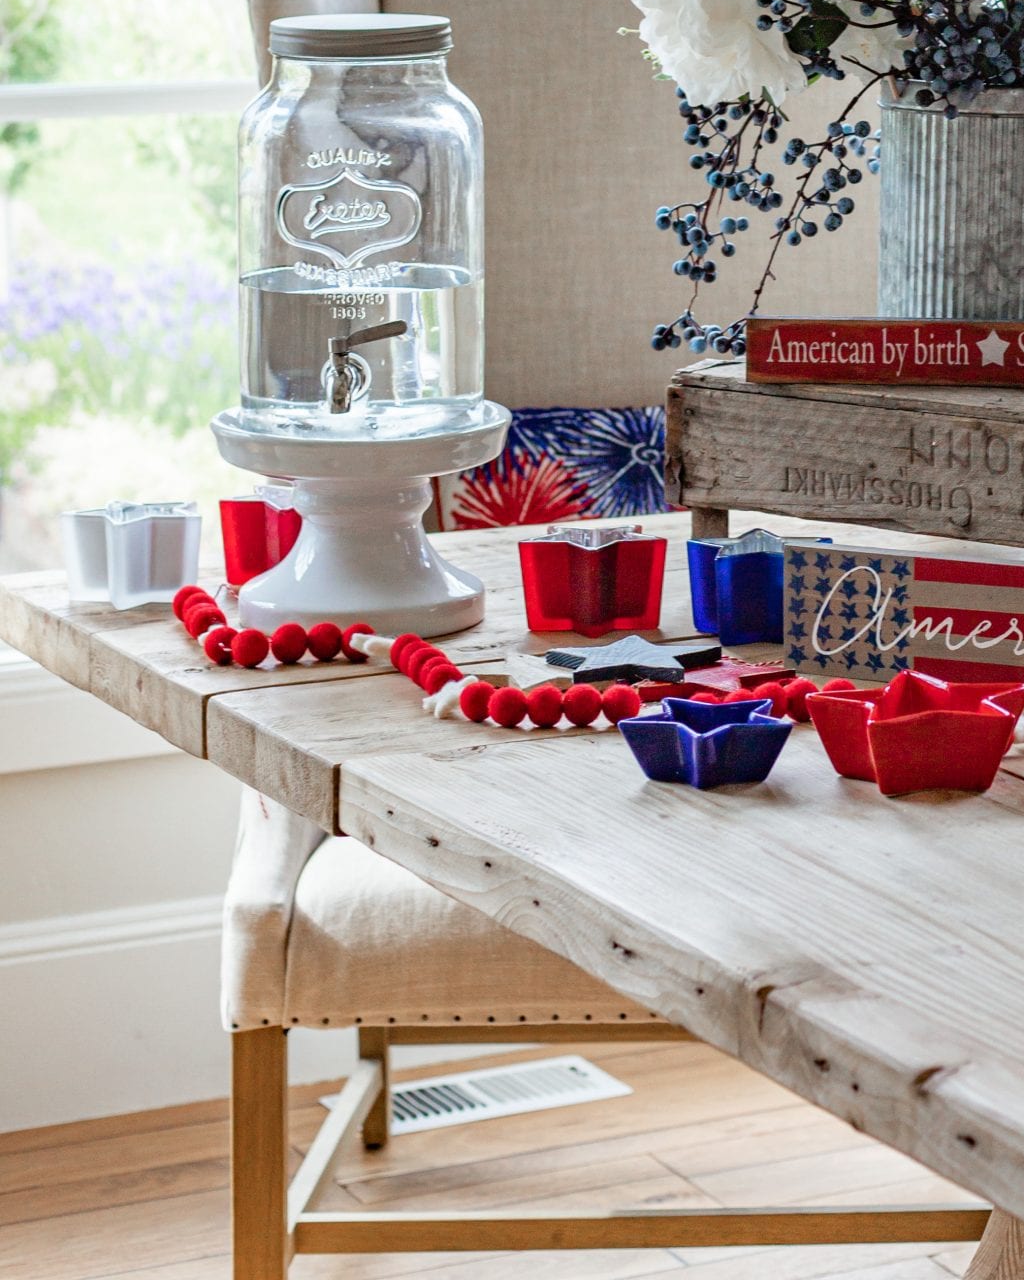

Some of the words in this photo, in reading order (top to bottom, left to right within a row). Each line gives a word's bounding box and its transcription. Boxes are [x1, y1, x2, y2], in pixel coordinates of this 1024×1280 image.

[306, 148, 392, 169] QUALITY
[304, 194, 391, 238] Exeter
[294, 261, 401, 288] GLASSWARE
[766, 328, 876, 364] American
[881, 327, 909, 377] by
[914, 327, 970, 366] birth
[780, 466, 973, 529] GROSSMARKT
